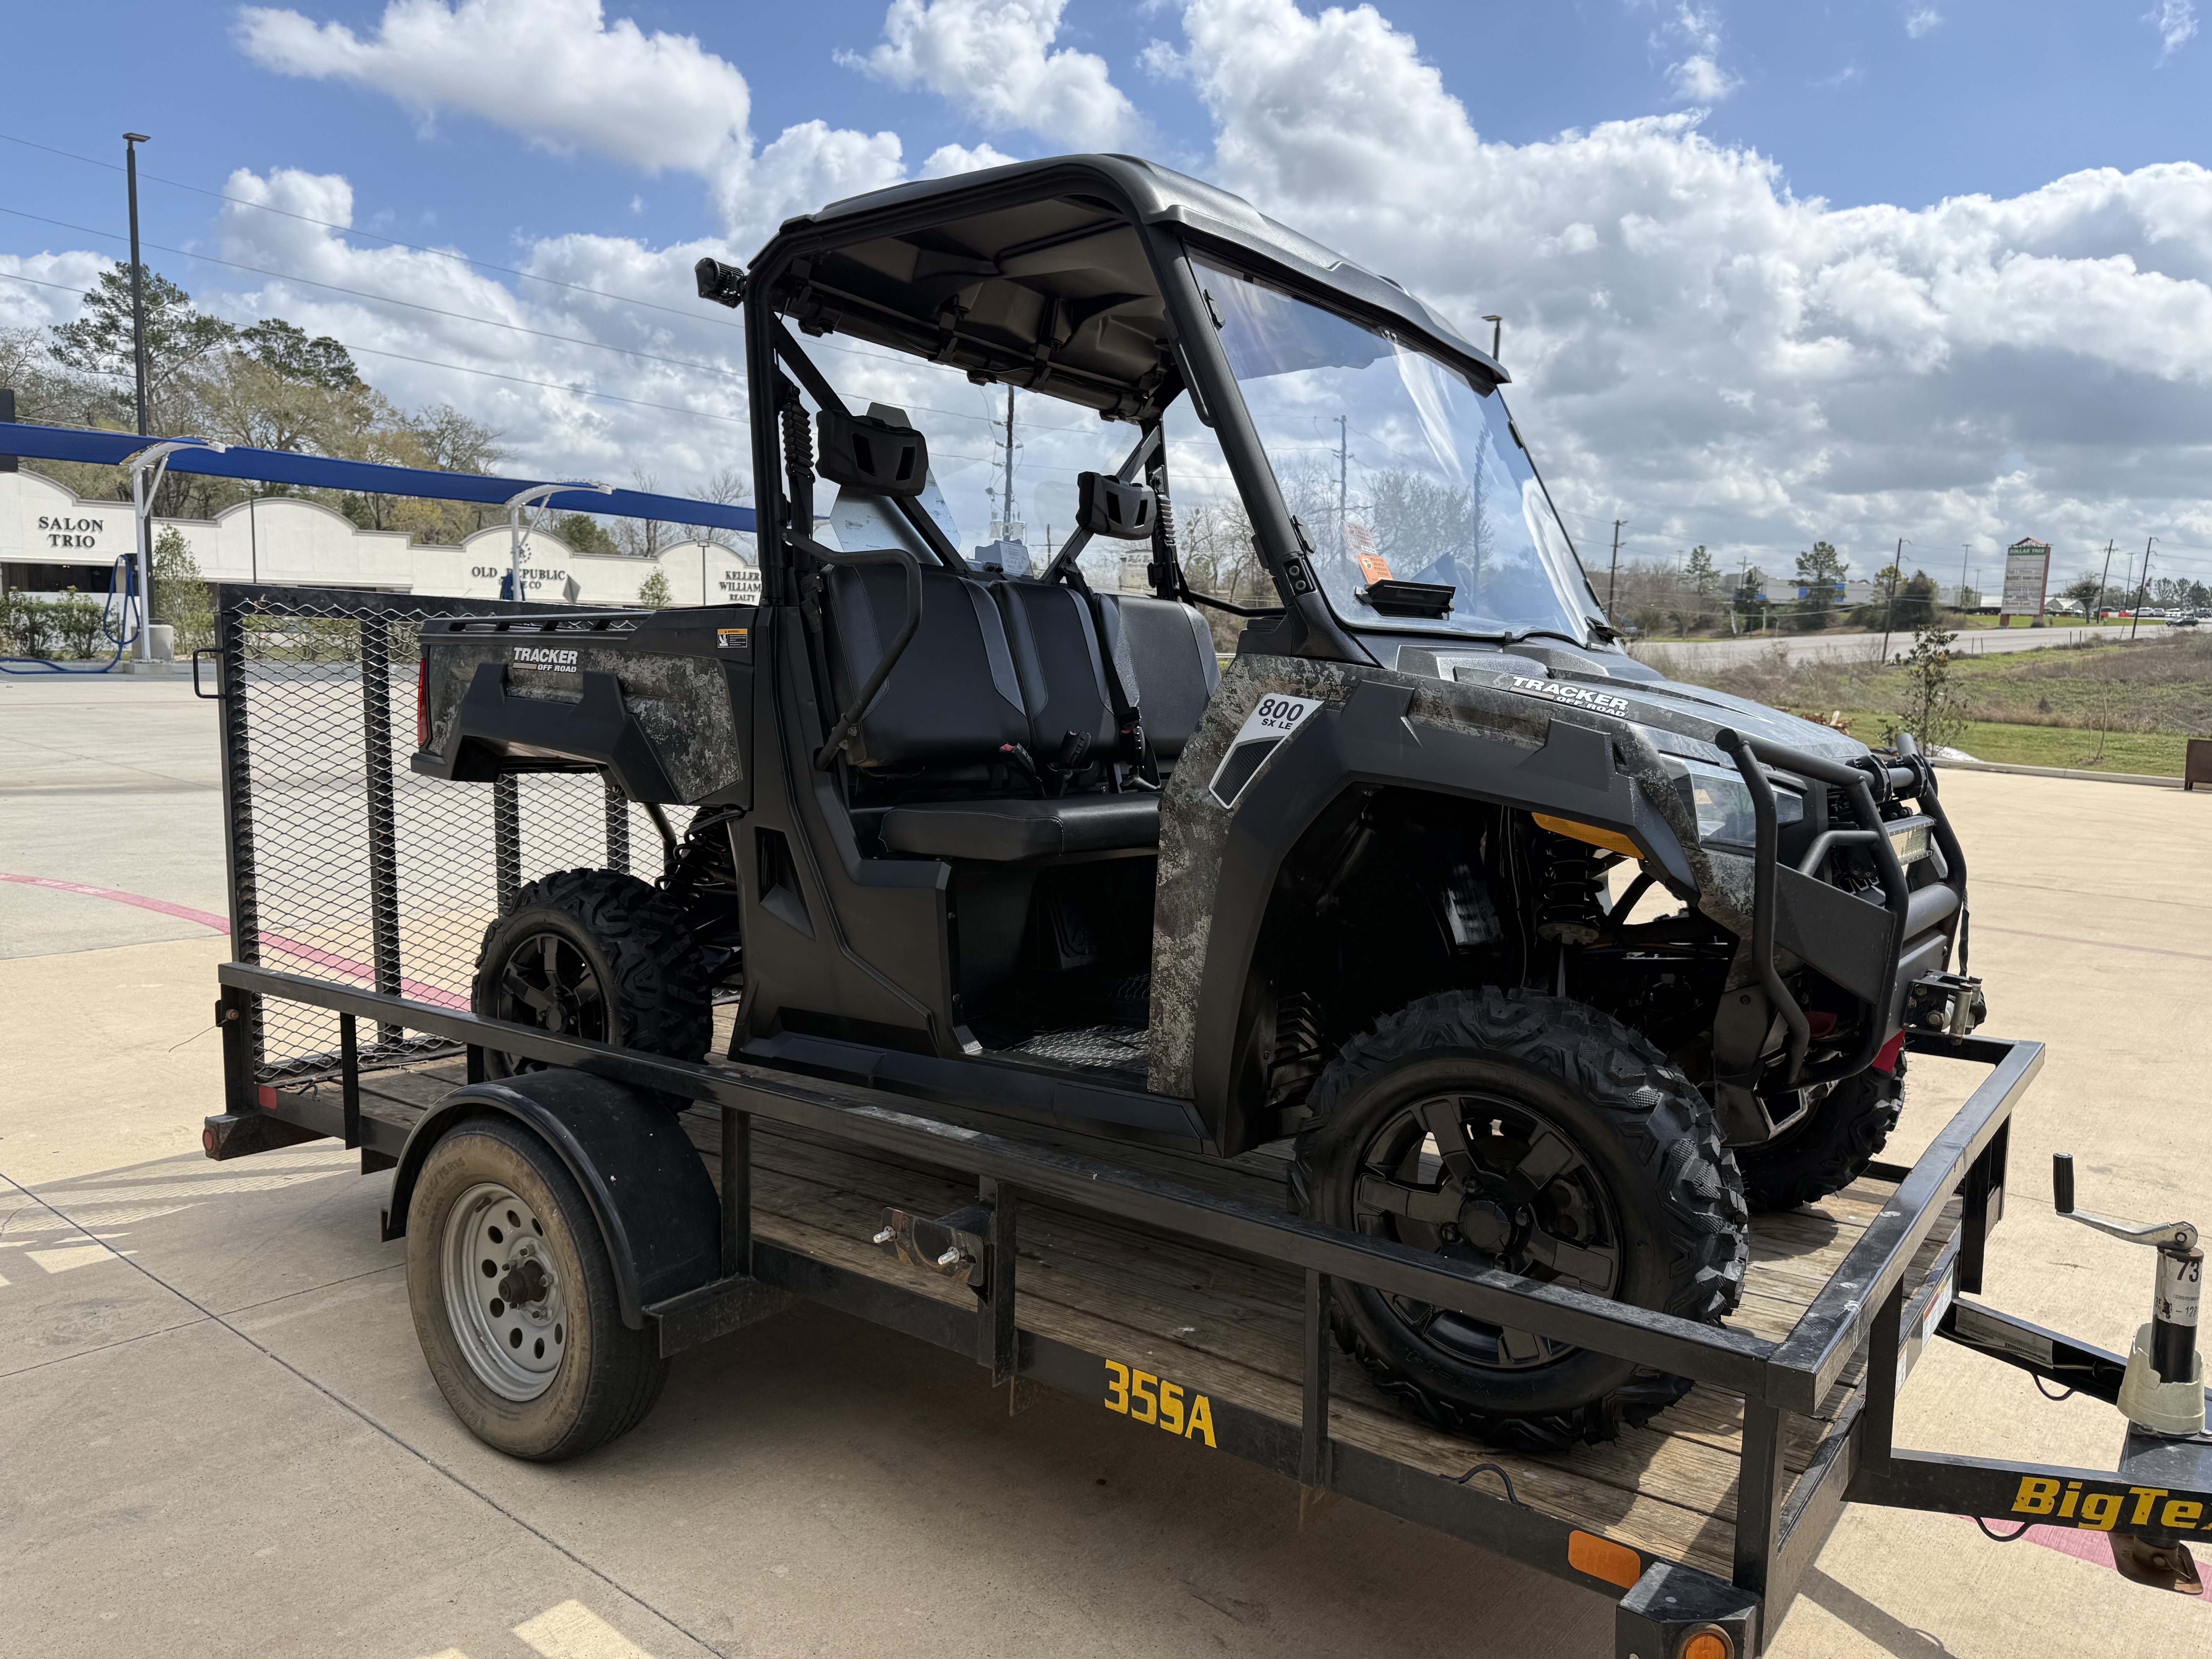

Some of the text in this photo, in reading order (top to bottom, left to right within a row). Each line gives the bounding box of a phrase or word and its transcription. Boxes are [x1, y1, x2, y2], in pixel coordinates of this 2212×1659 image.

[38, 516, 104, 533] SALON
[49, 533, 96, 549] TRIO
[472, 567, 566, 580] OLD RPUBLIC
[725, 571, 760, 581] KELLER
[719, 582, 761, 592] WILLIAM
[729, 594, 756, 602] REALTY
[514, 647, 578, 665] TRACKER
[1512, 676, 1629, 711] TRACKER
[1258, 699, 1304, 721] 800
[1556, 696, 1626, 717] OFF ROAD
[1261, 718, 1293, 730] SX LE
[1104, 1358, 1218, 1449] 35SA
